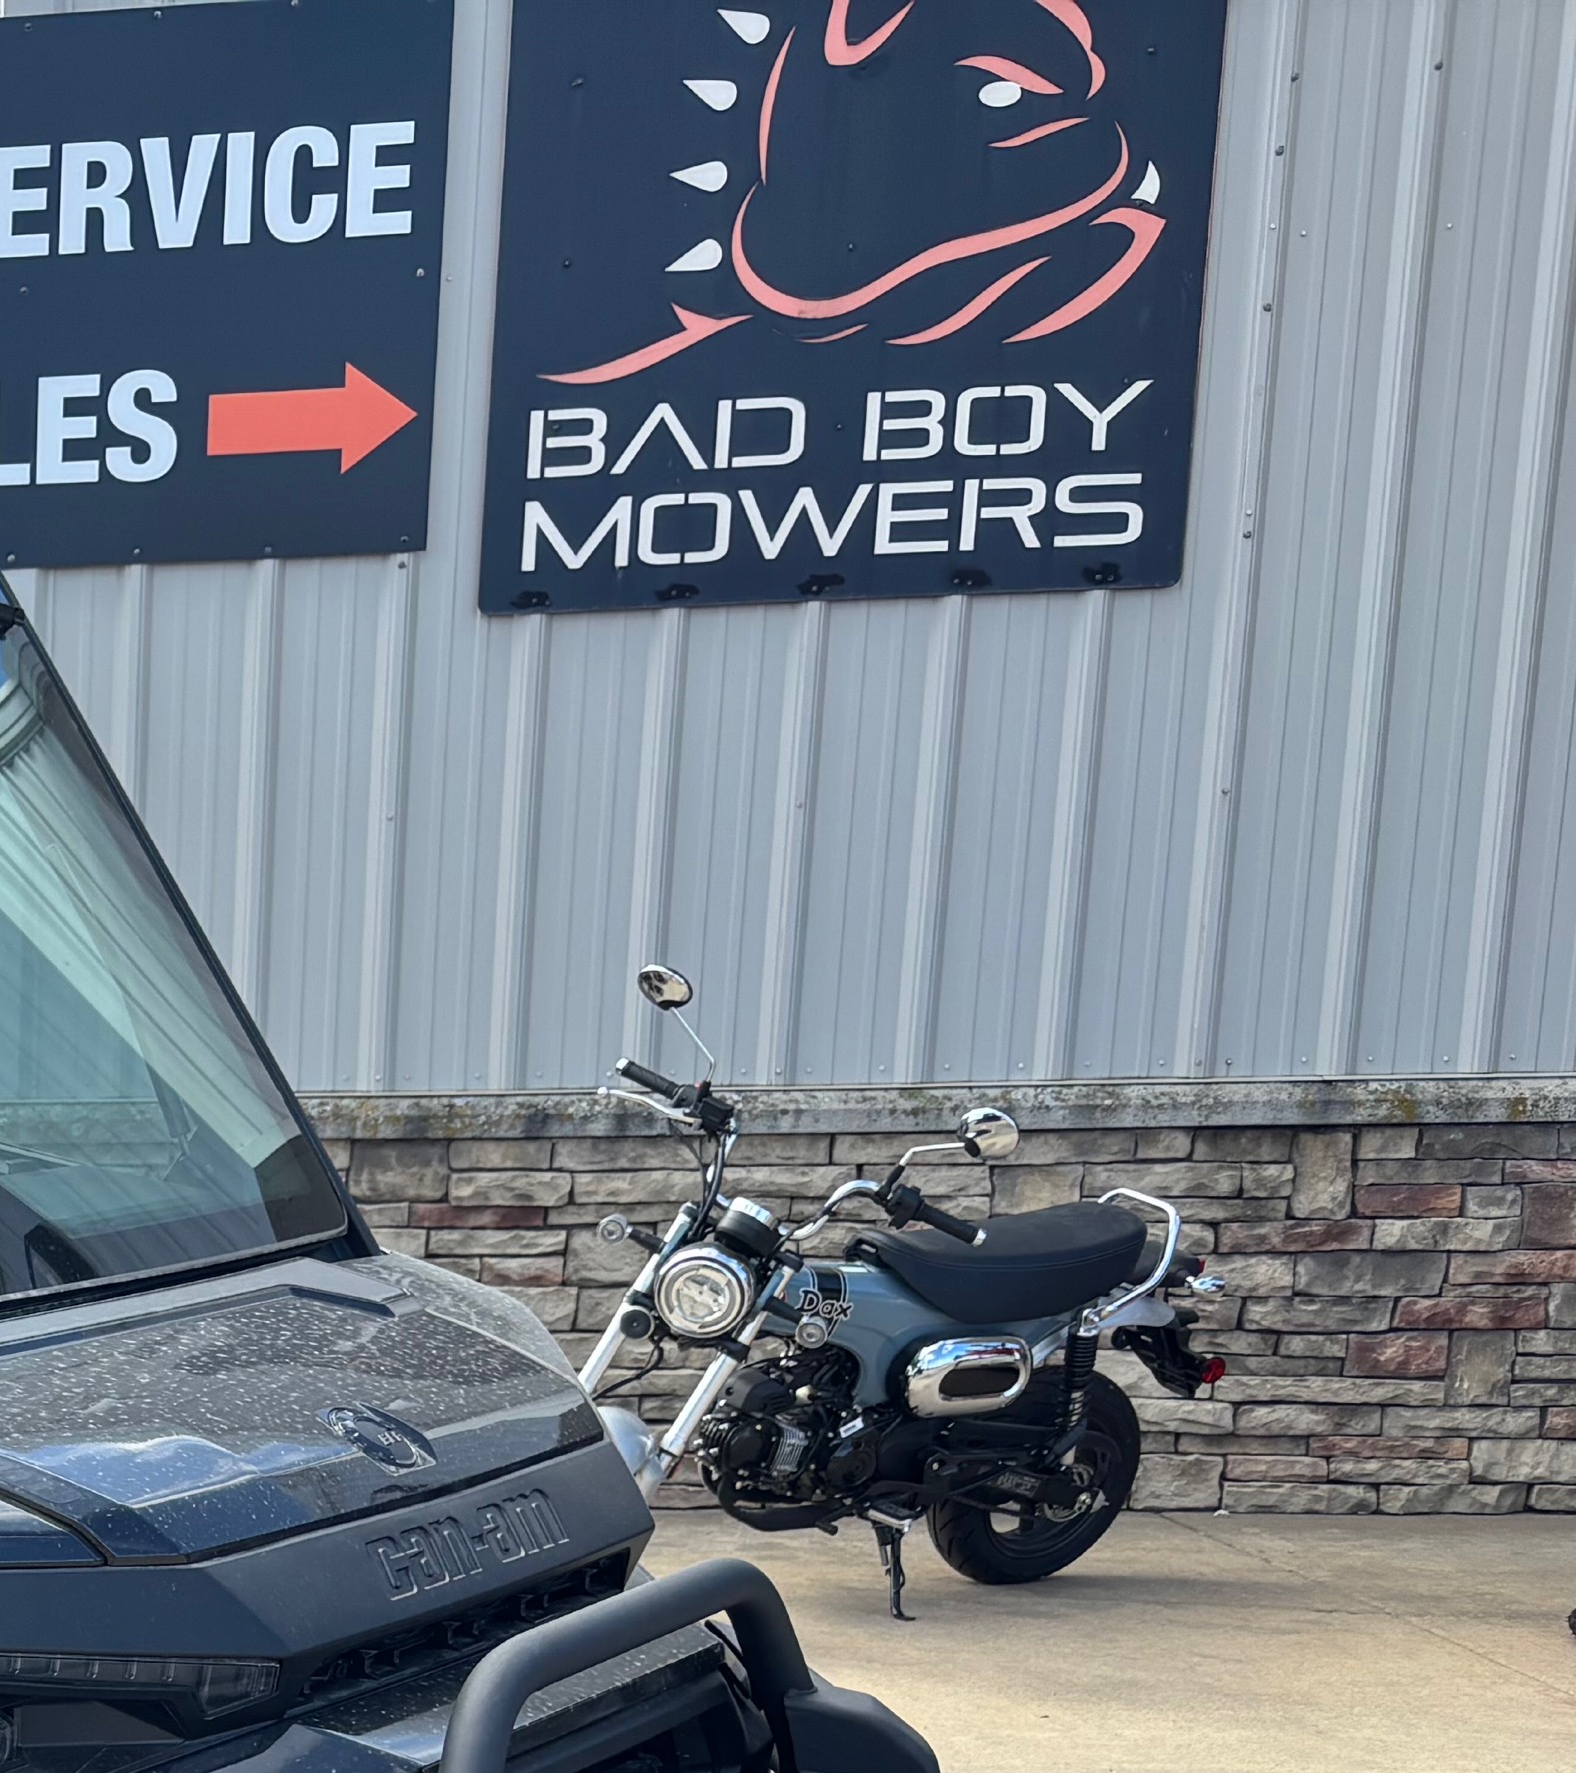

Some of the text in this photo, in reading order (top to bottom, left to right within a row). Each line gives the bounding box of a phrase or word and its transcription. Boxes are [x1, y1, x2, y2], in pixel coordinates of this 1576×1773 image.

[525, 379, 1154, 480] BAD BOY
[520, 472, 1146, 573] MOWERS
[796, 1288, 854, 1320] Dax
[365, 1487, 571, 1601] can-am
